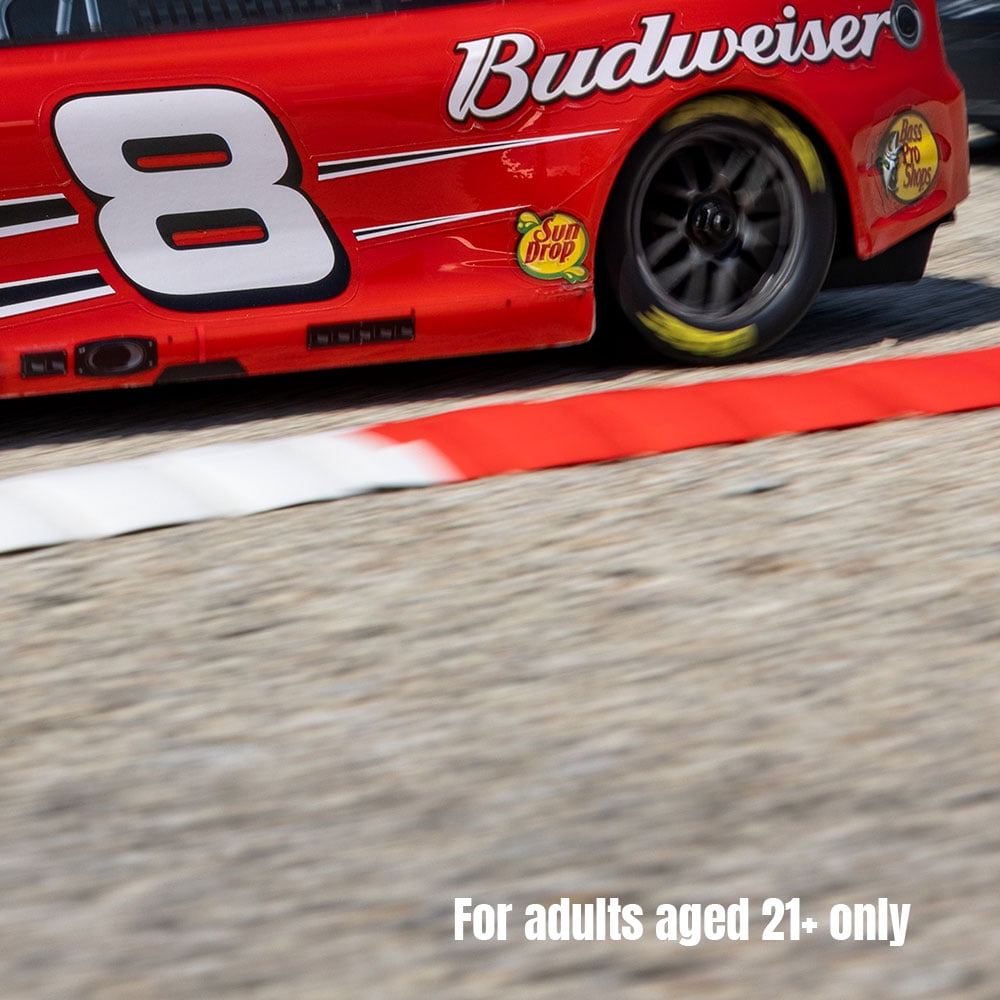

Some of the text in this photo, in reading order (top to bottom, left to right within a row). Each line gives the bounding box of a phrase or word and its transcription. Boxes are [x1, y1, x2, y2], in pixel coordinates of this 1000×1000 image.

[446, 5, 892, 123] Budweiser
[900, 118, 923, 143] Bass
[902, 142, 920, 165] Pro
[903, 163, 932, 192] Shops
[52, 86, 340, 300] 8
[533, 217, 581, 243] Sun
[524, 241, 576, 265] Drop
